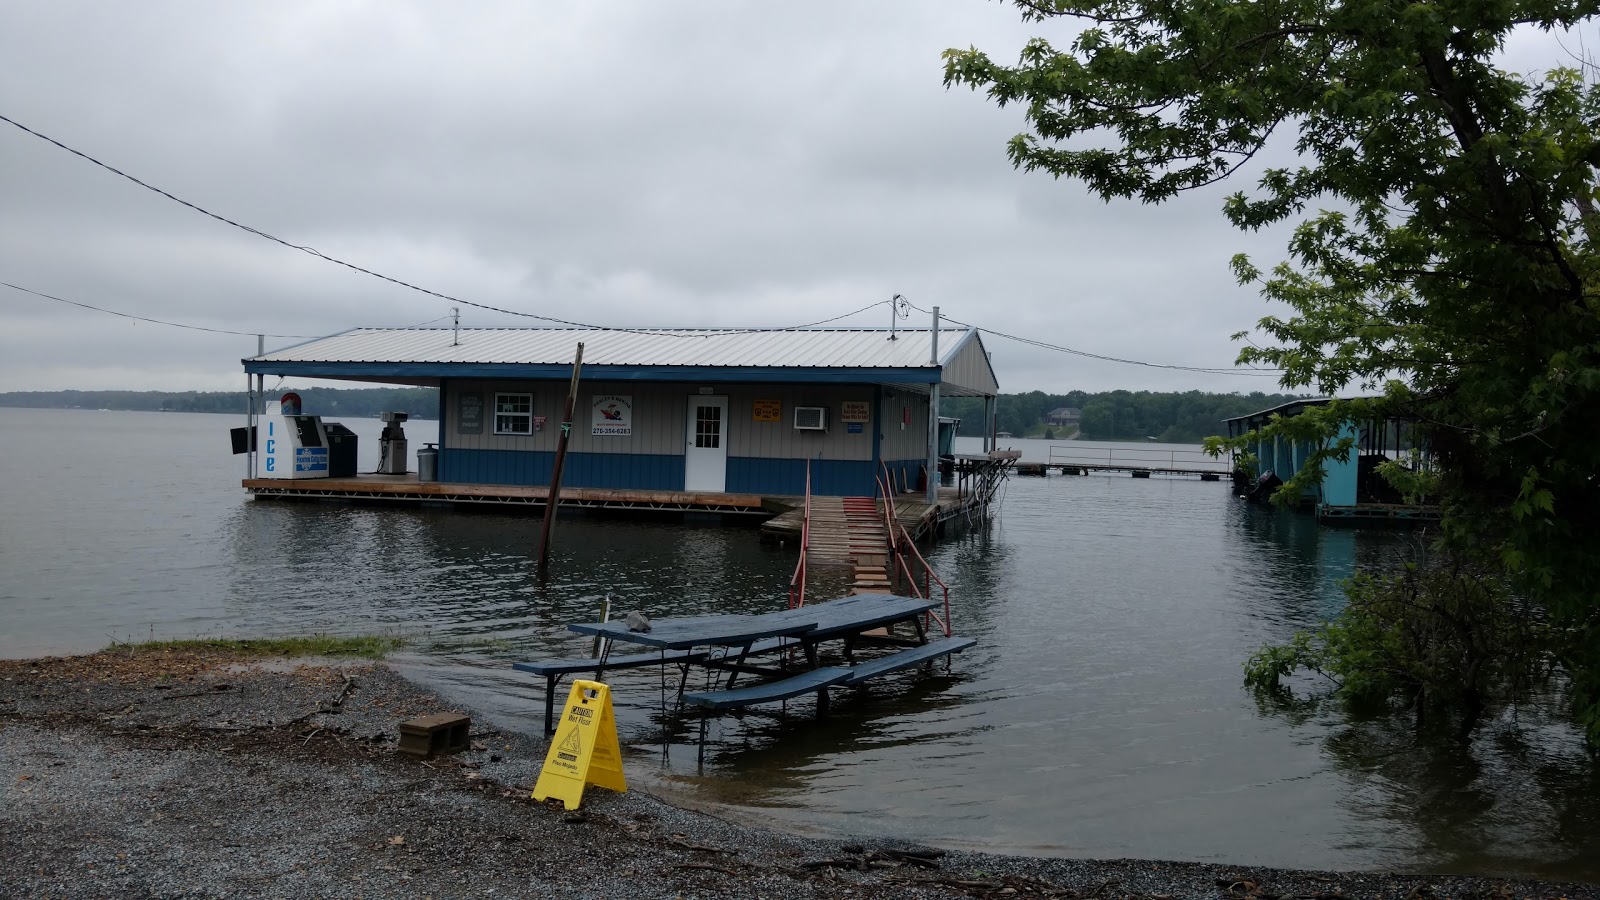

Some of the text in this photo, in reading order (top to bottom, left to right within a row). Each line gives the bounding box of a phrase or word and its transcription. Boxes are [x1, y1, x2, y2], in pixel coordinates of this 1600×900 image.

[571, 706, 593, 718] CAUTION
[568, 714, 591, 725] Wet Floor
